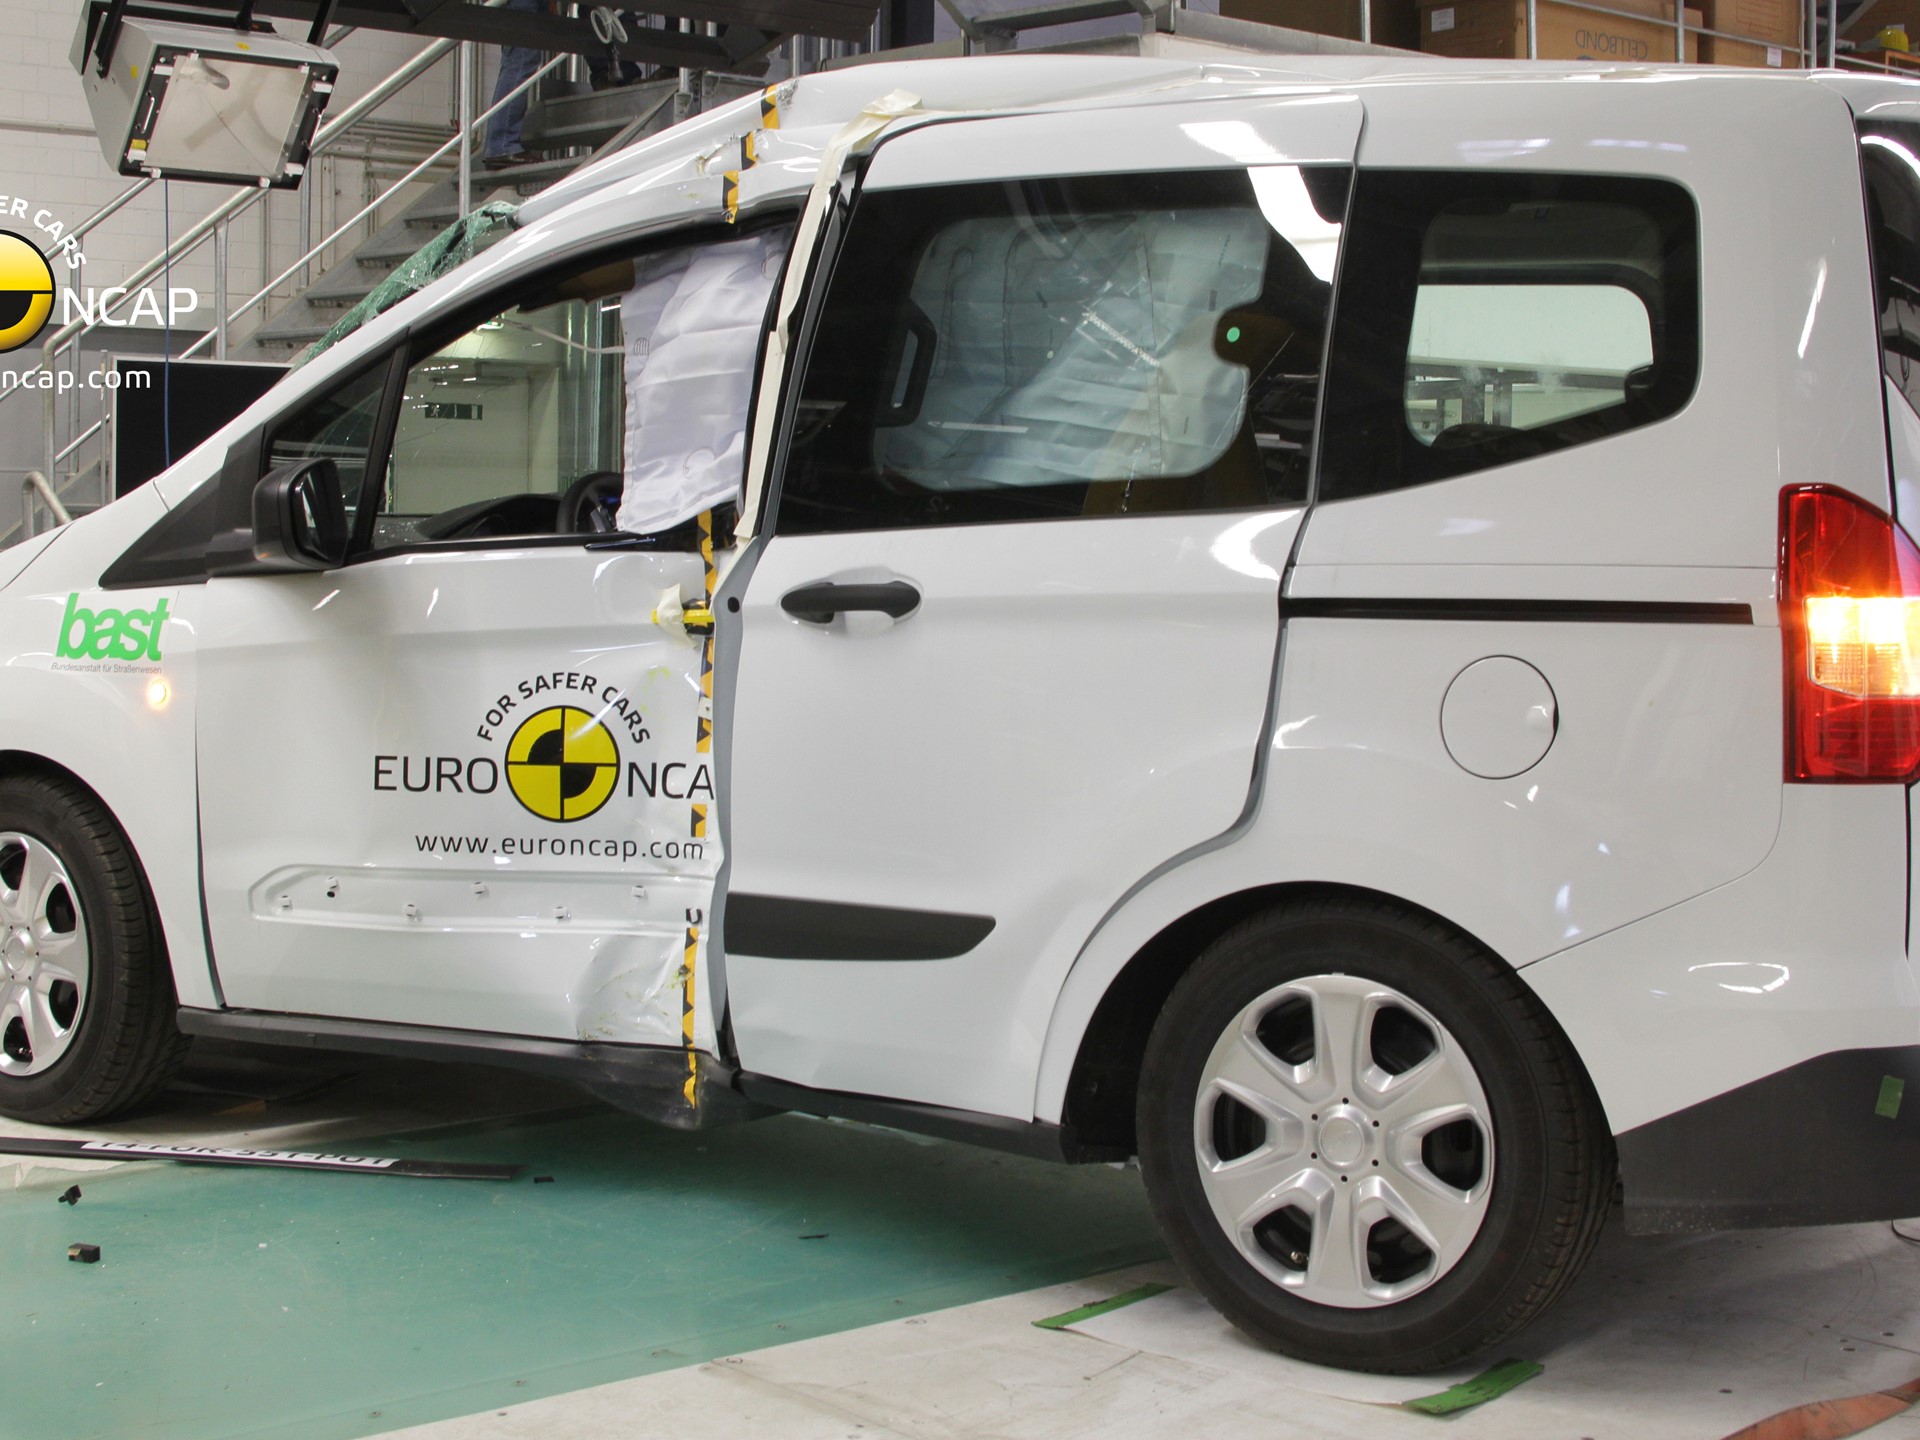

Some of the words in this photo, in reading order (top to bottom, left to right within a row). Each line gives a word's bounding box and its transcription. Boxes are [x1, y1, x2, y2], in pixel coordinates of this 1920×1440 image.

[1575, 29, 1648, 59] CELLBOND
[56, 592, 170, 662] bast
[476, 694, 516, 742] FOR
[517, 671, 598, 700] SAFER
[601, 685, 651, 744] CARS
[373, 755, 499, 795] EURO
[415, 835, 704, 862] www.euroncap.com
